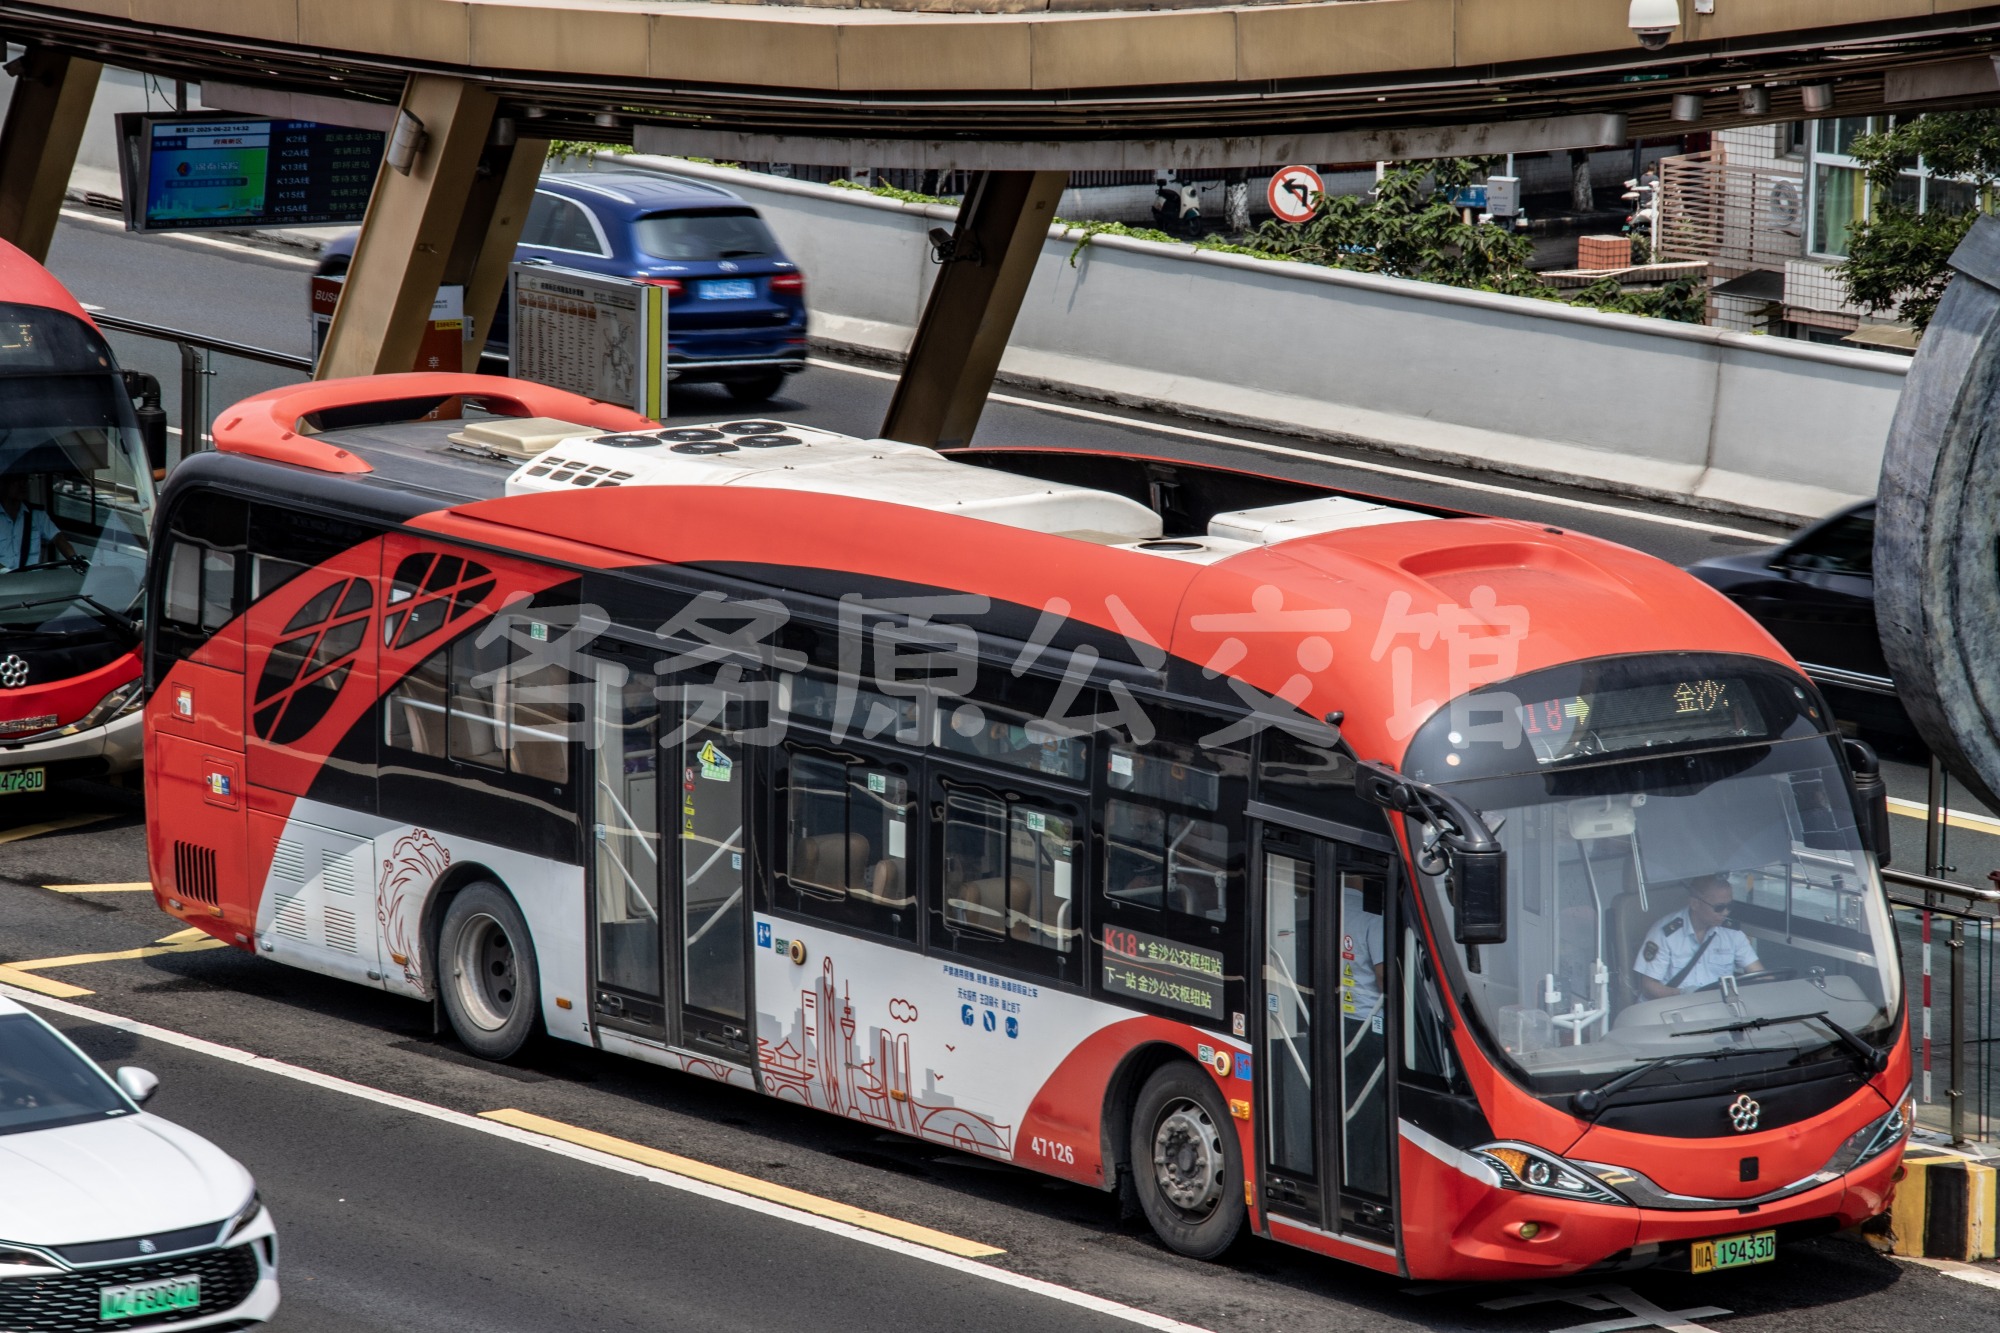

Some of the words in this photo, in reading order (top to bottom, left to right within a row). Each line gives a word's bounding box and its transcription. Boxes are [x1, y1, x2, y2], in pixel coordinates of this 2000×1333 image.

[286, 135, 308, 143] K2线
[281, 149, 309, 157] K2A线
[281, 163, 308, 171] K13线
[276, 176, 310, 185] K13A线
[279, 190, 306, 199] K15线
[274, 204, 308, 213] K15A线
[1673, 679, 1729, 713] 金沙
[1104, 927, 1137, 957] K18
[1147, 941, 1222, 976] 金沙公交枢纽站
[1105, 966, 1137, 990] 下一站
[1138, 975, 1212, 1009] 金沙公交枢纽站
[1031, 1136, 1075, 1165] 47126
